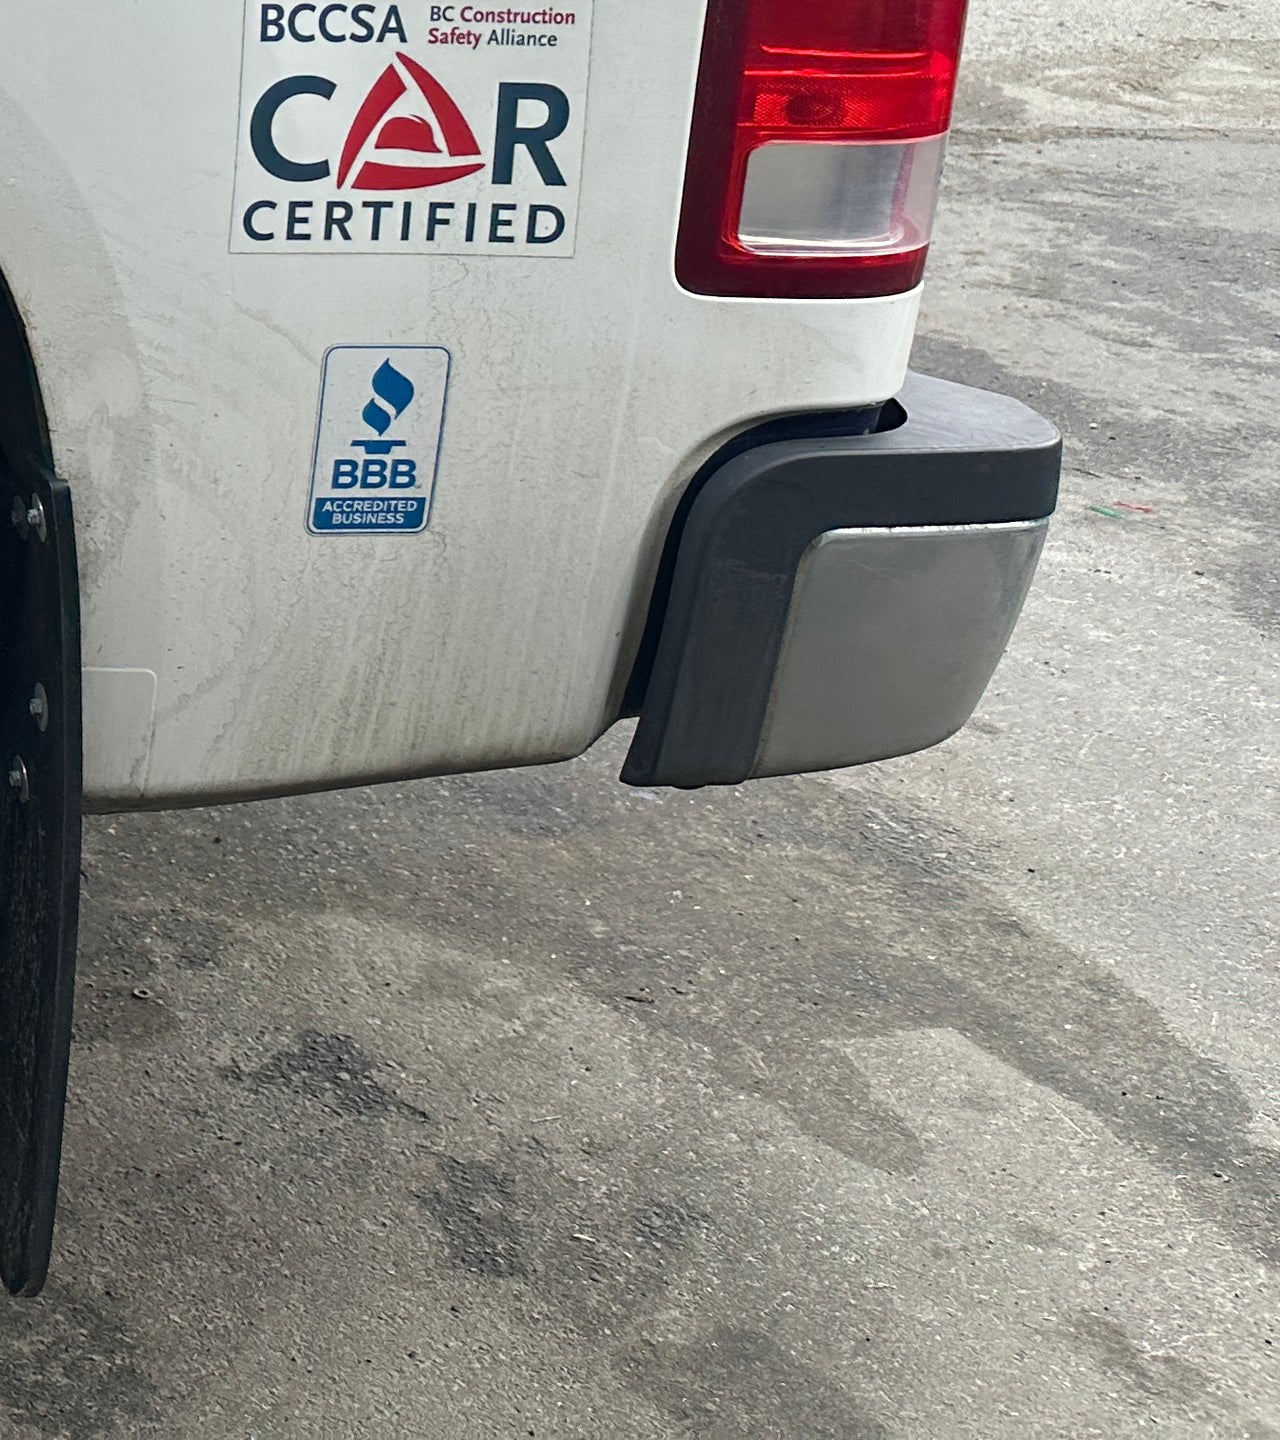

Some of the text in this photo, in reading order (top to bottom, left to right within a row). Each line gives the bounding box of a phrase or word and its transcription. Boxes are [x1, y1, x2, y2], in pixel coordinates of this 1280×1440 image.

[260, 3, 408, 44] BCCSA
[429, 5, 576, 26] BC Construction
[427, 26, 559, 50] Safety Alliance
[242, 199, 566, 244] CERTIFIED
[331, 458, 417, 490] BBB
[321, 500, 418, 513] ACCREDITED
[331, 512, 405, 525] BUSINESS
